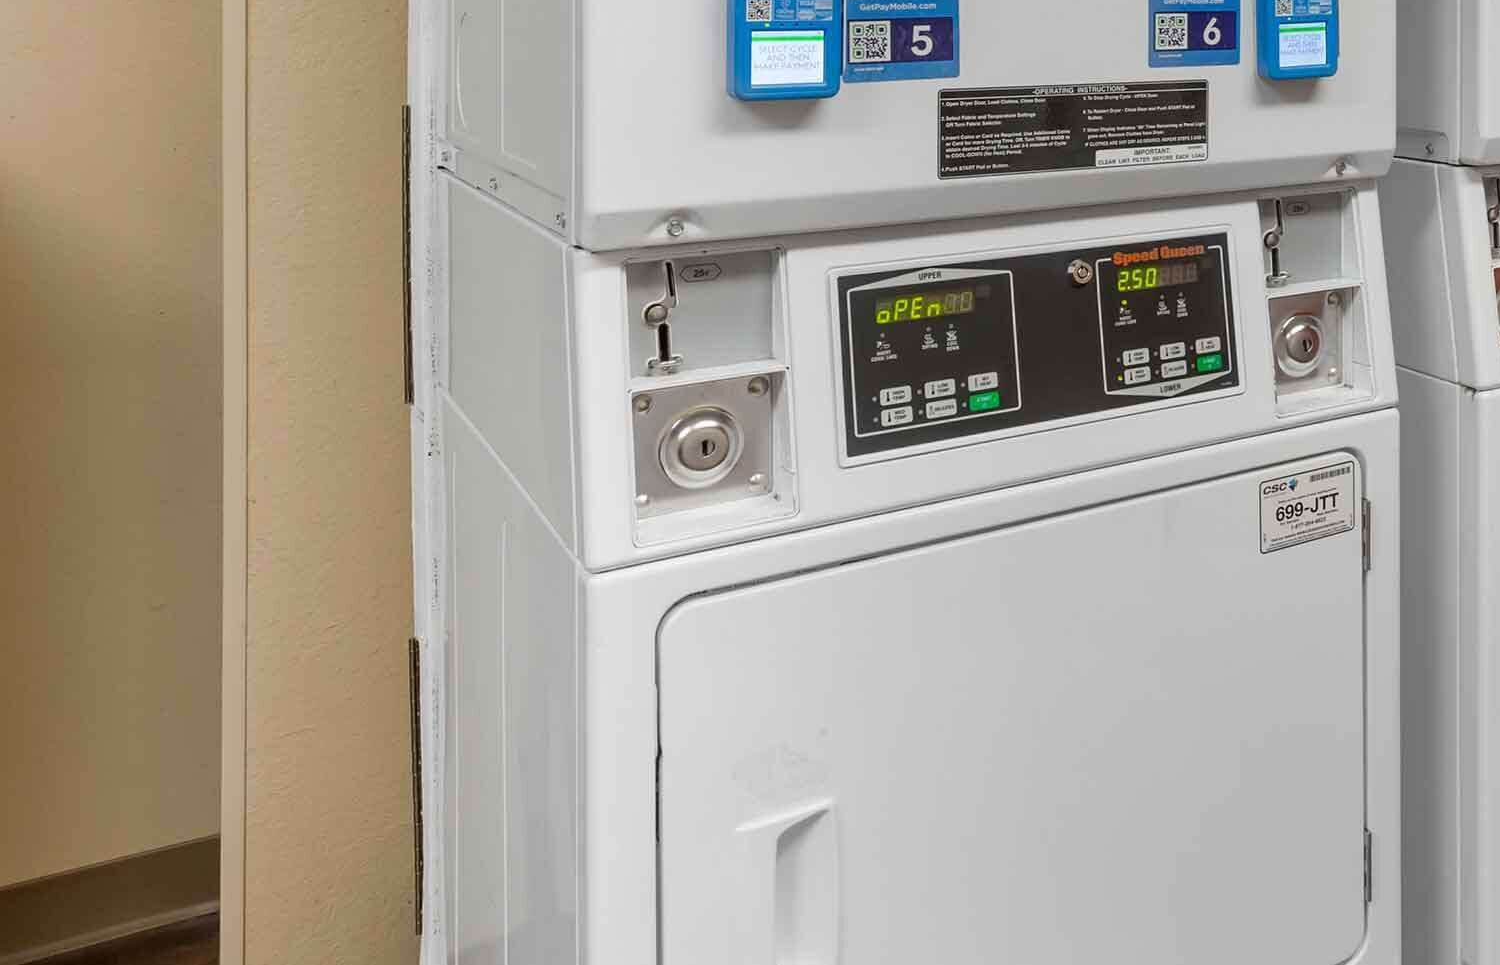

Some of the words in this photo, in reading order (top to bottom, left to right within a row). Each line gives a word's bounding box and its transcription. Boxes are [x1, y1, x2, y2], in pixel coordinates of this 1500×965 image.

[859, 2, 936, 11] GetPayMobile.com
[1203, 17, 1221, 45] 6
[911, 25, 934, 56] 5
[1134, 148, 1170, 156] IMPORTANT
[1112, 248, 1159, 265] Speed
[1160, 245, 1205, 260] Queen
[918, 271, 942, 281] UPPER
[1118, 268, 1158, 291] 2.50
[1160, 382, 1181, 394] LOWER
[1263, 482, 1288, 496] CSC
[1275, 492, 1340, 522] 699-JTT
